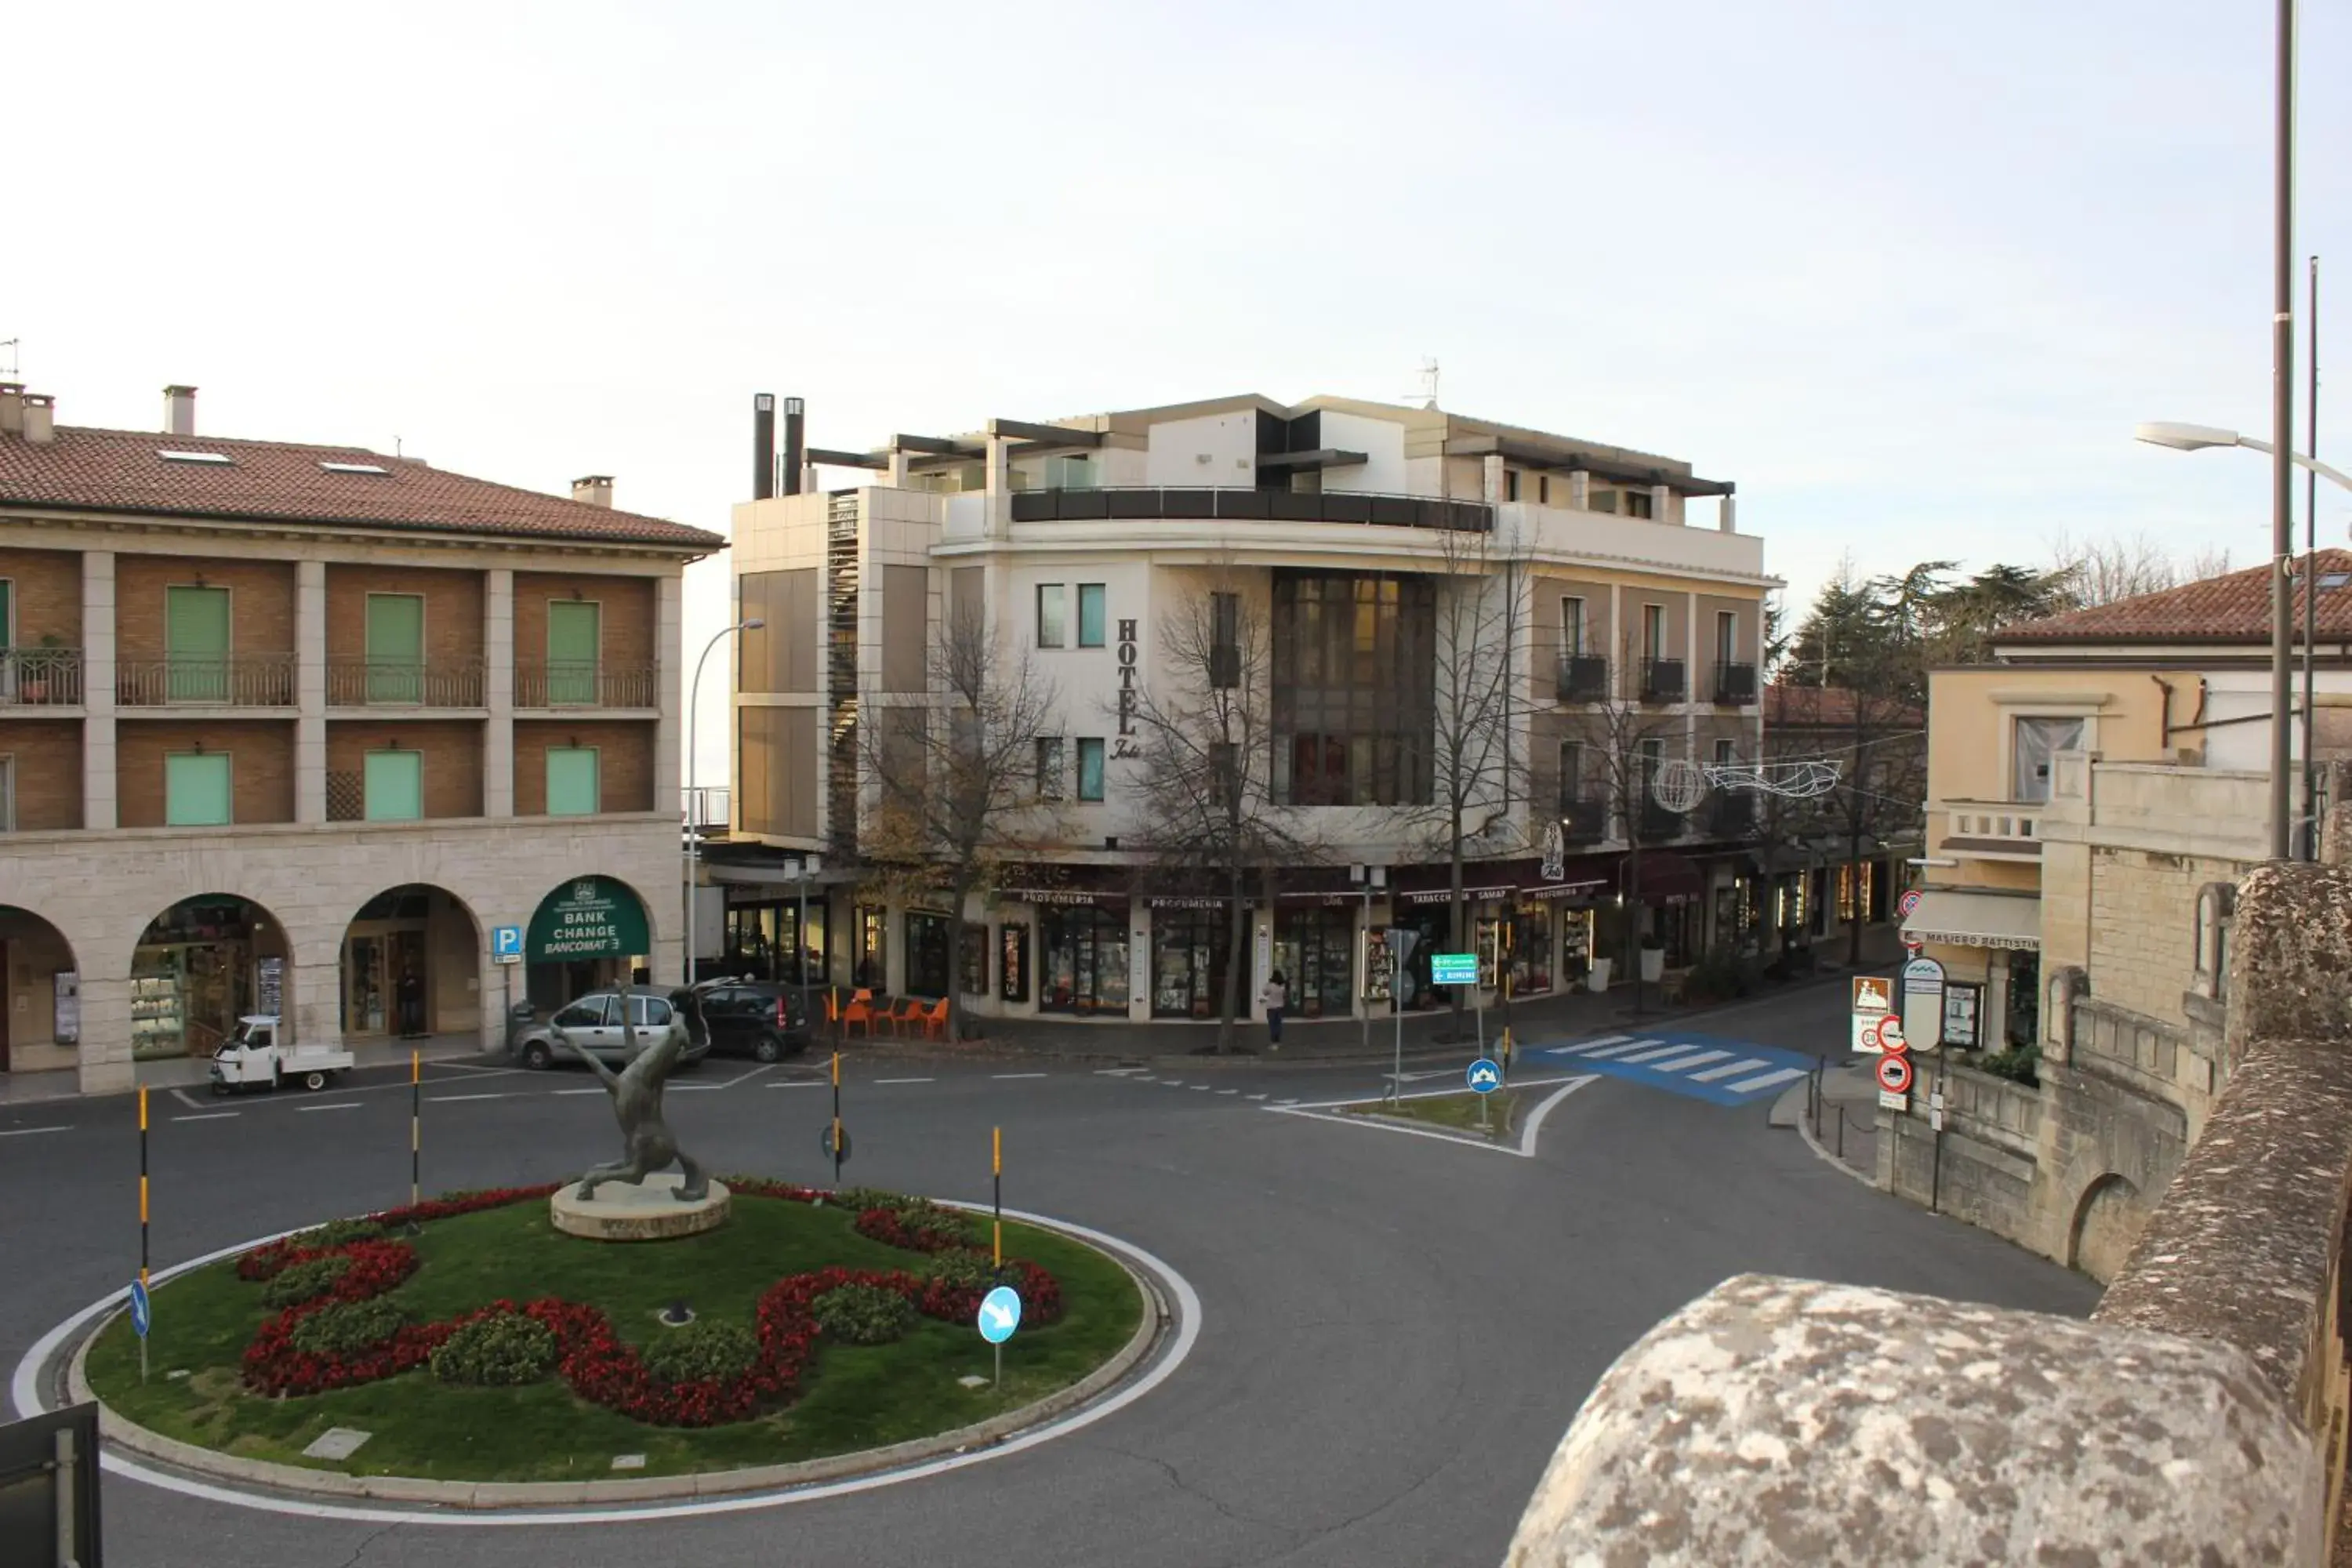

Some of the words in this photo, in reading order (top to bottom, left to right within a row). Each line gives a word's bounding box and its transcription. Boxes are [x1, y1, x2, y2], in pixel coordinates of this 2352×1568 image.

[1117, 619, 1137, 735] HOTEL
[564, 912, 606, 924] BANK
[554, 925, 616, 939] CHANGE
[500, 929, 517, 953] P
[545, 941, 606, 954] BANCOMAT
